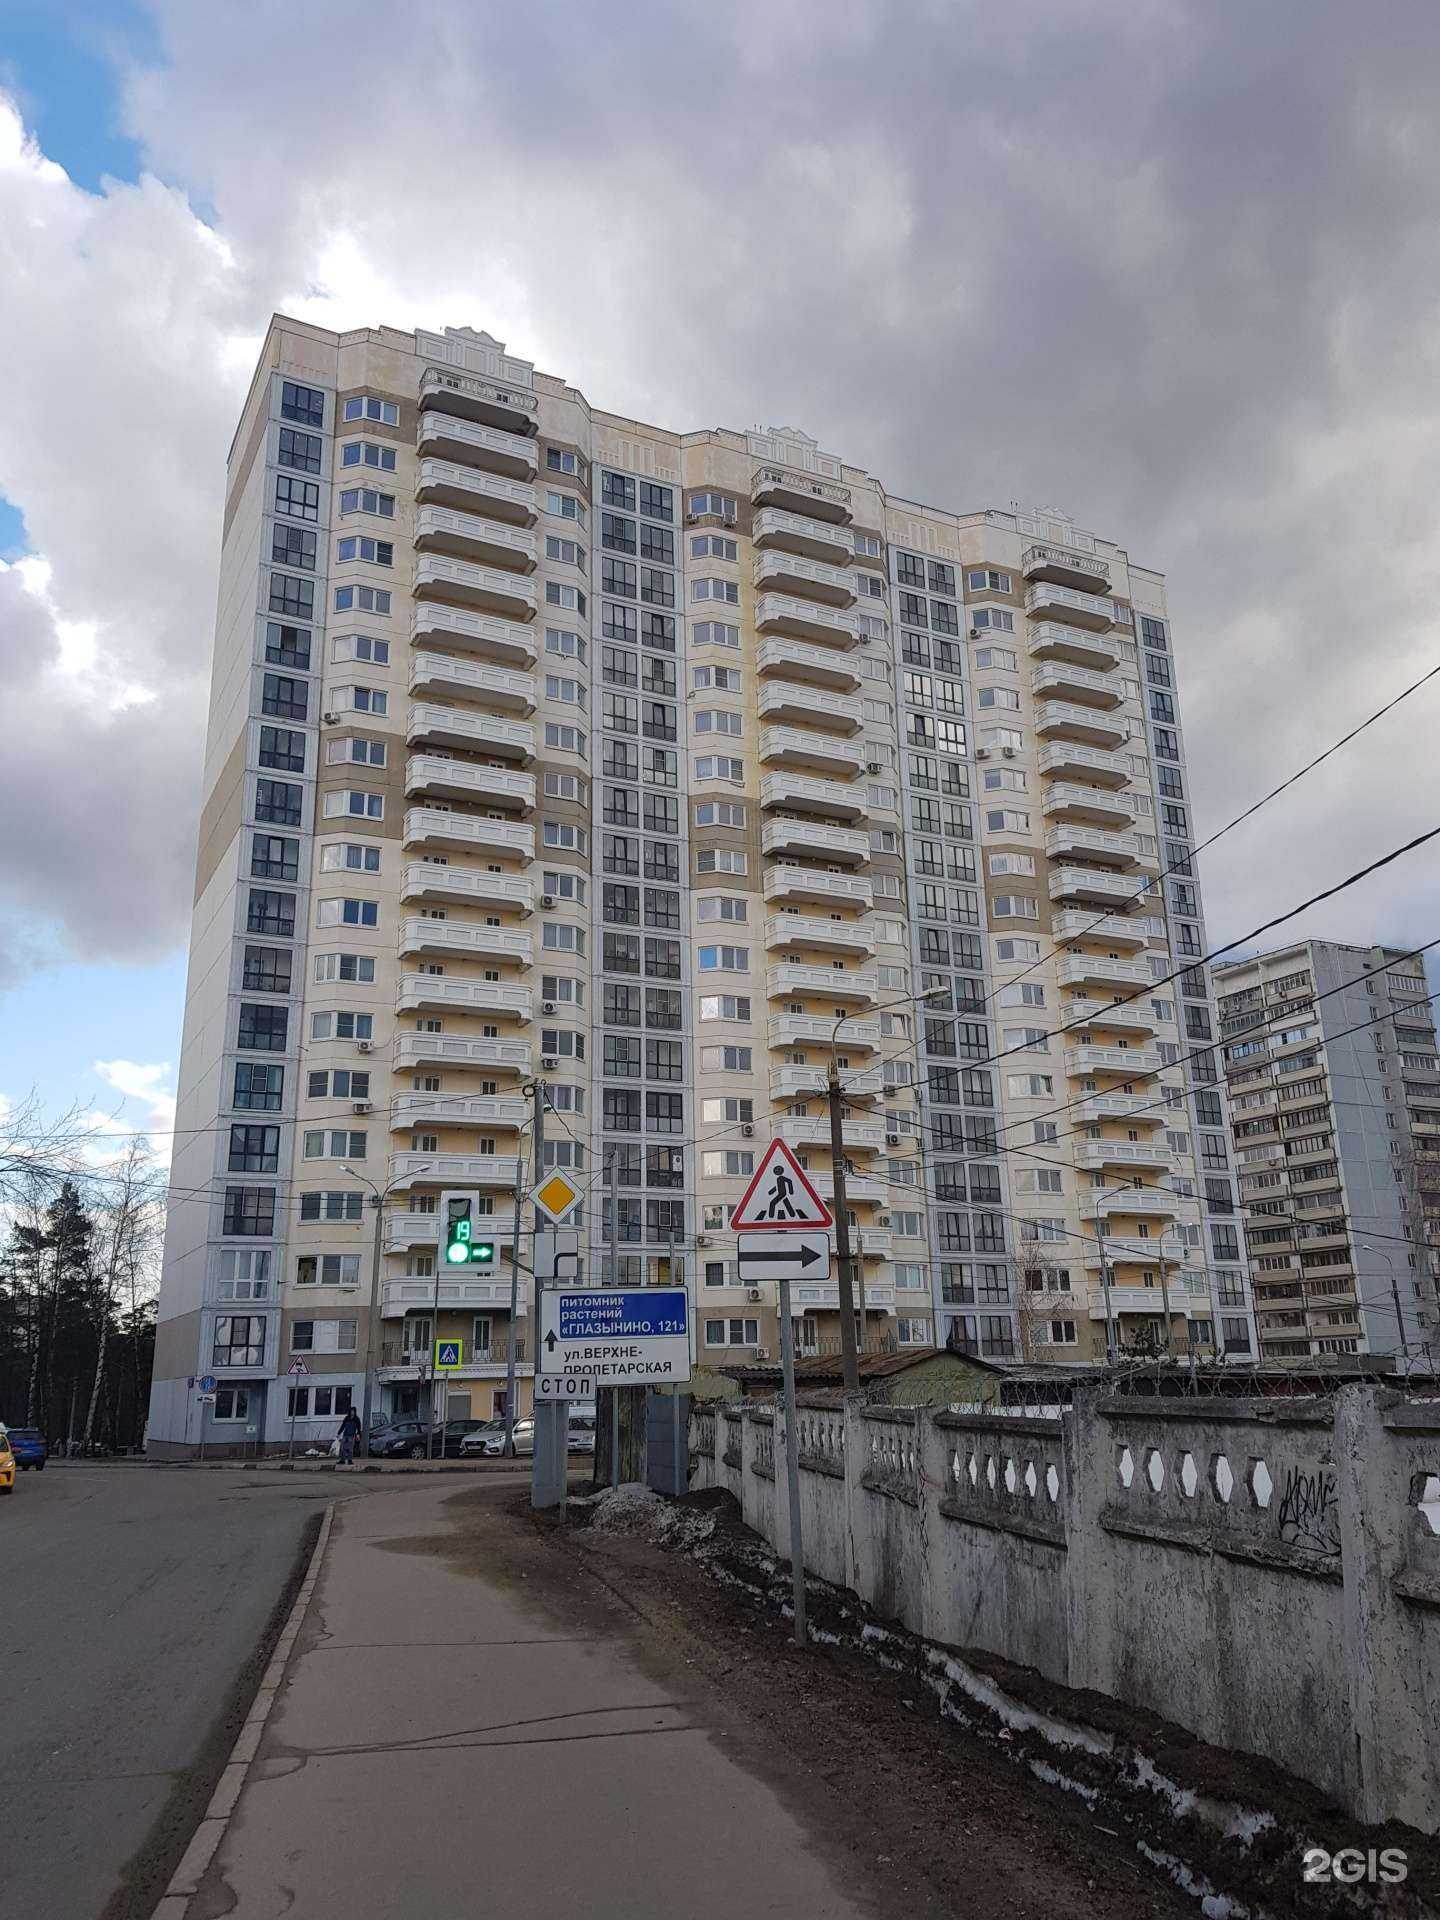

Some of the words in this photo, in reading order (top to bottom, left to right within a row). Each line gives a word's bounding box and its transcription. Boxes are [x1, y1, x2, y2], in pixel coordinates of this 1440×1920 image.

[457, 1221, 470, 1241] 19
[561, 1297, 625, 1307] питомник
[561, 1307, 623, 1322] растений
[562, 1321, 655, 1335] «ГЛАЗЫНИНО,
[658, 1320, 685, 1332] 121»
[564, 1346, 643, 1362] ул.ВЕРХНЕ-
[541, 1378, 590, 1394] СТОП
